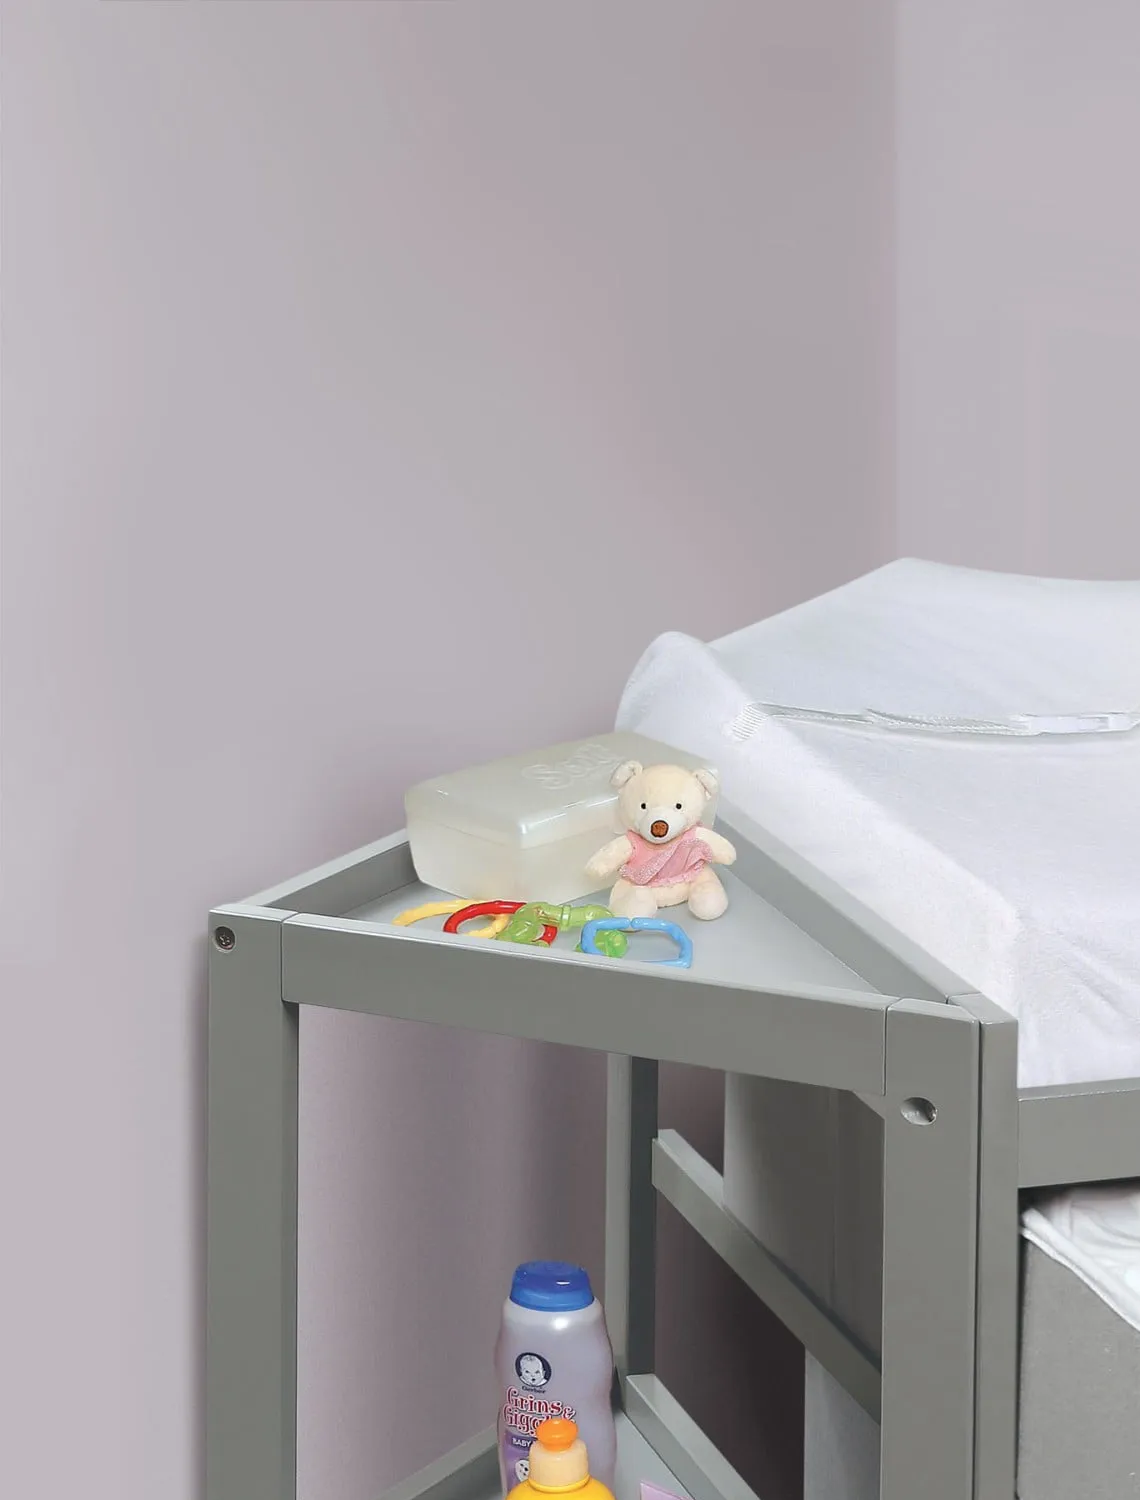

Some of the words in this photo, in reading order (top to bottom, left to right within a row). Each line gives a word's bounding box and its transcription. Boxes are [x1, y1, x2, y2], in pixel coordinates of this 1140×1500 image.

[507, 1386, 561, 1414] Grins
[562, 1407, 576, 1419] &
[512, 1437, 532, 1447] BABY
